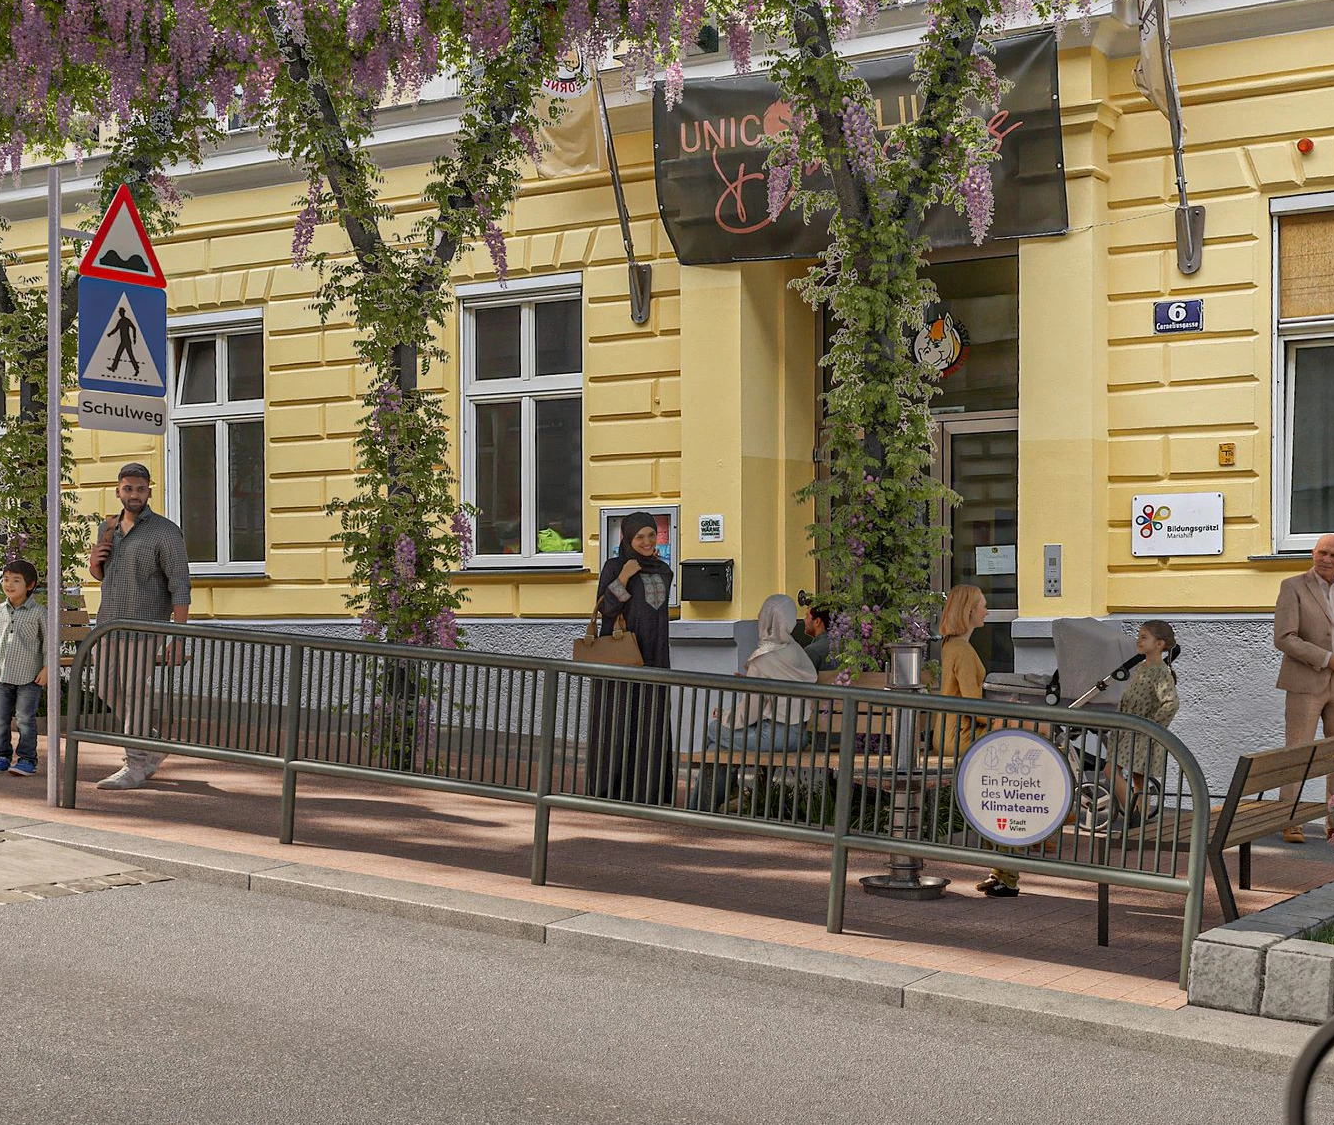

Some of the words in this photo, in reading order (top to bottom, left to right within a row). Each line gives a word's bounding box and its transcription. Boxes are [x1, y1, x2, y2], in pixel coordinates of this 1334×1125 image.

[1168, 302, 1187, 322] 6
[82, 401, 163, 427] Schulweg
[1167, 524, 1219, 534] Bildungsgrätzl
[981, 775, 998, 786] Ein
[1001, 776, 1041, 790] Projekt
[981, 788, 1001, 799] des
[1003, 789, 1046, 801] Wiener
[981, 800, 1049, 814] Klimateams
[1009, 818, 1027, 826] Stadt
